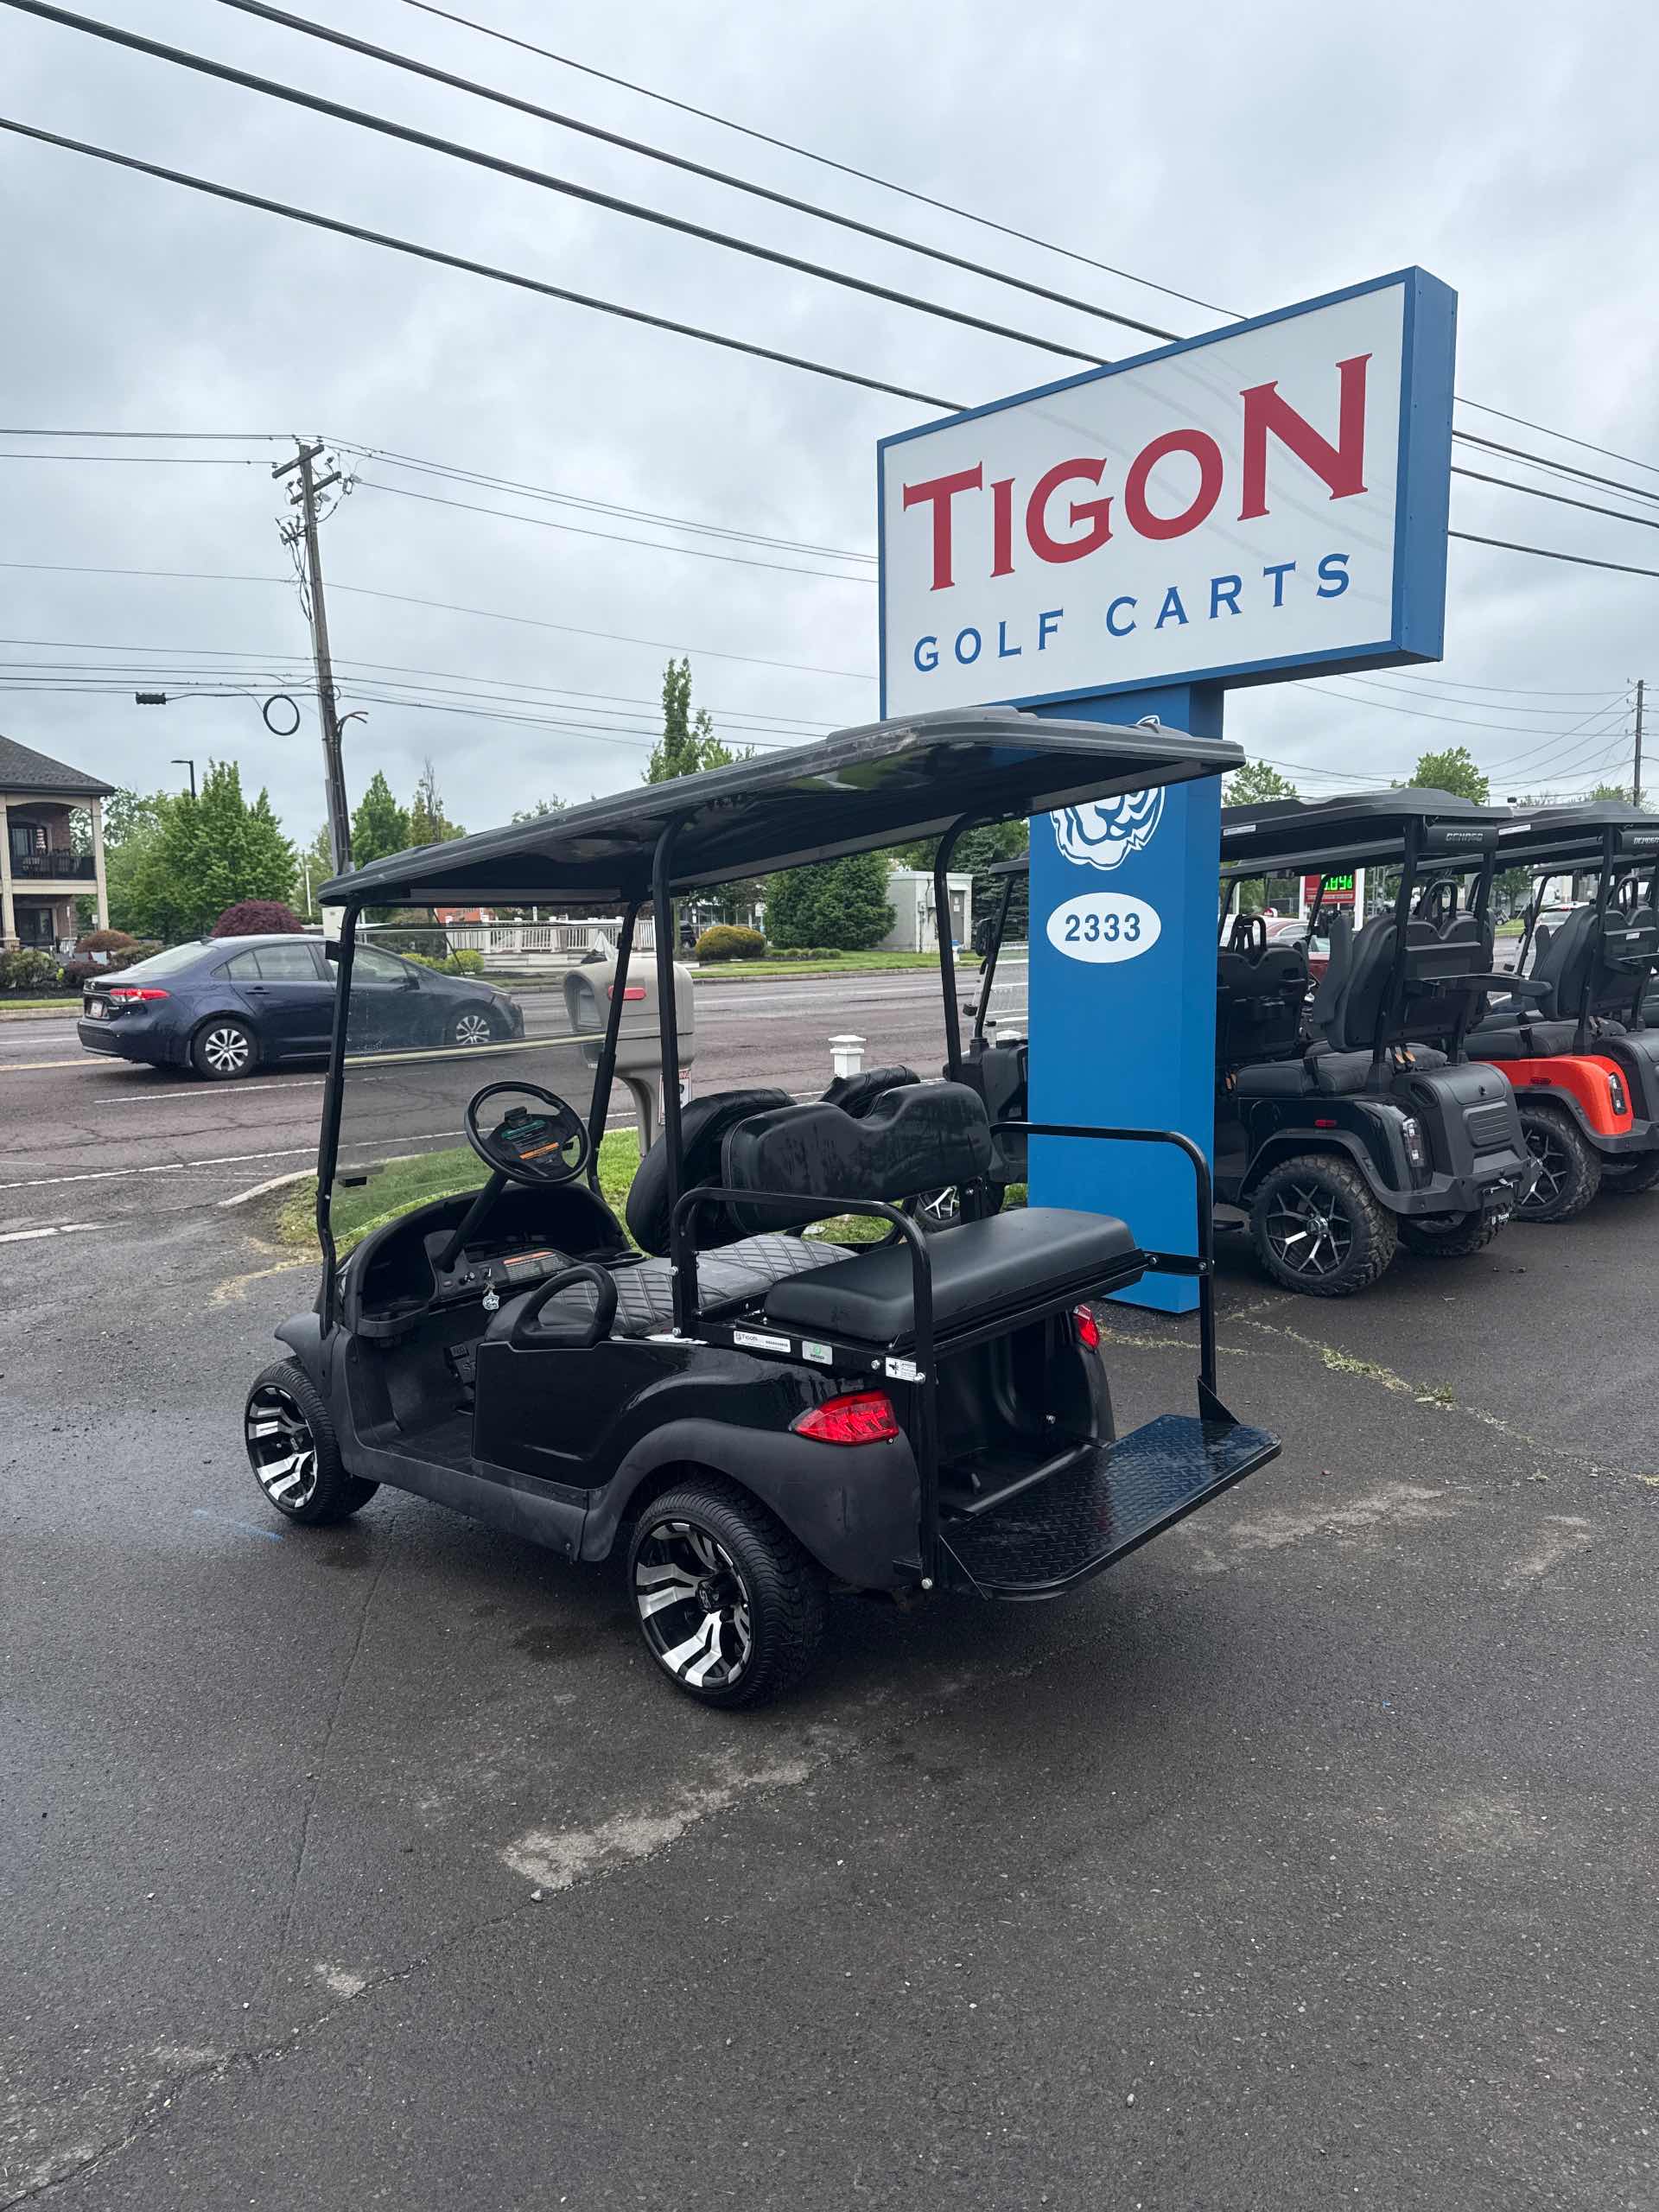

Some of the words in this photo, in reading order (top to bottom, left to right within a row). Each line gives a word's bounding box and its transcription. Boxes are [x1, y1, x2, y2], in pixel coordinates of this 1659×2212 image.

[903, 353, 1372, 591] TIGON
[913, 607, 1064, 672] GOLF
[1105, 553, 1350, 637] CARTS
[1065, 913, 1141, 942] 2333
